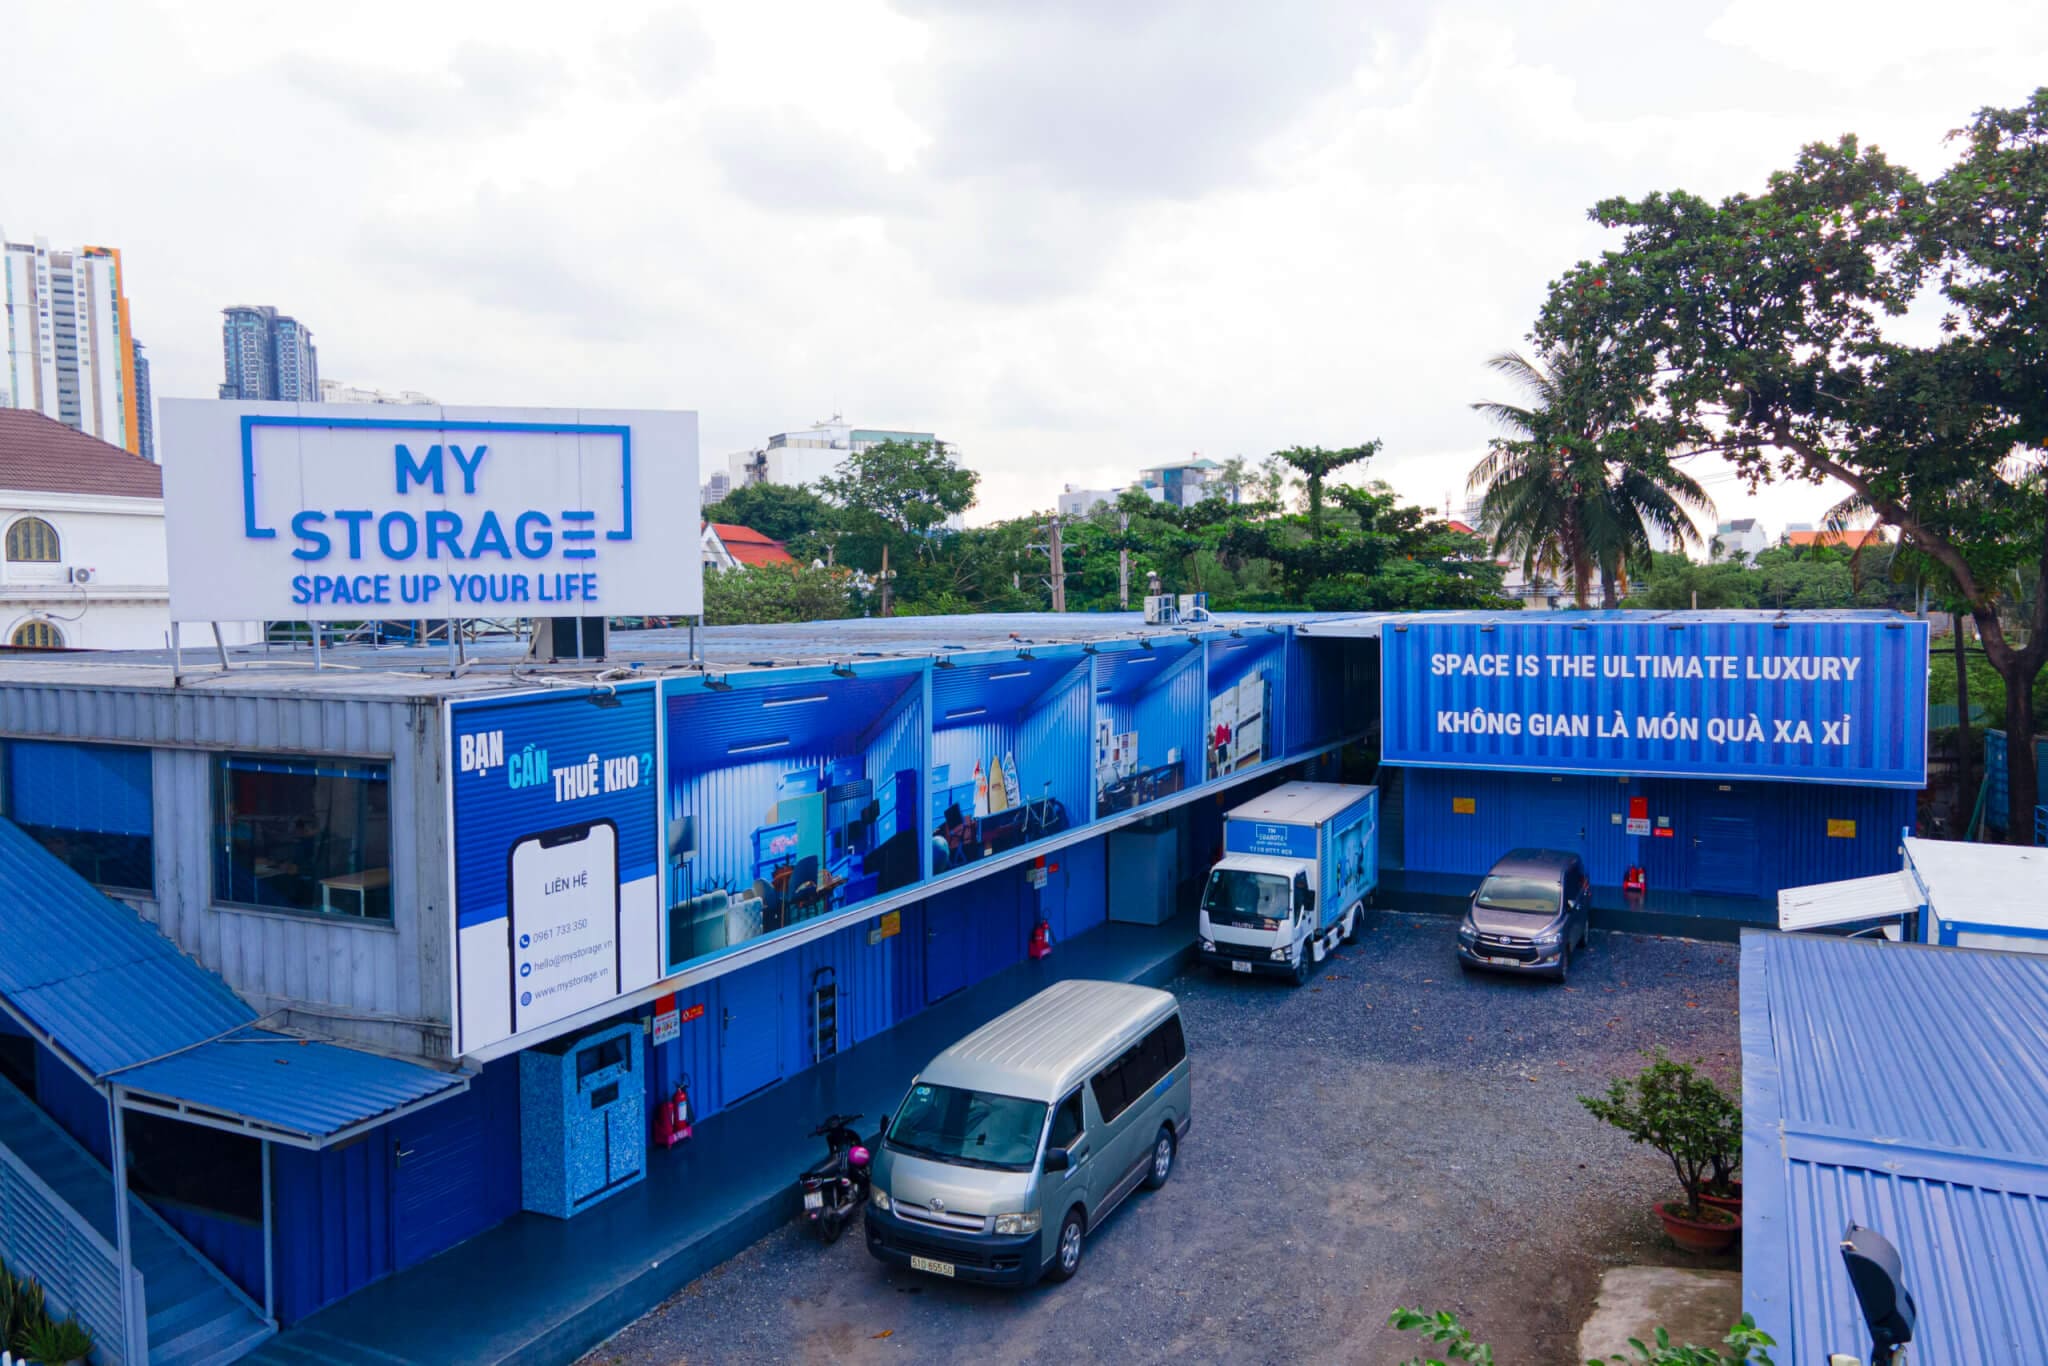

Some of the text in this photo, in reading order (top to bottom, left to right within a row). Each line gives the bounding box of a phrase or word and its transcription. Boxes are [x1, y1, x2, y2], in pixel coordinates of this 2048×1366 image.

[394, 444, 488, 494] MY
[291, 510, 597, 561] STORAGE
[292, 572, 598, 604] SPACE UP YOUR LIFE
[1431, 653, 1861, 681] SPACE IS THE ULTIMATE LUXURY
[1437, 706, 1852, 745] KHÔNG GIAN LÀ MÓN QUÀ XA XỈ
[460, 730, 504, 777] BẠN
[508, 743, 549, 790] CẦN
[552, 753, 600, 803] THUÊ
[544, 870, 588, 896] LIÊN HỆ
[533, 929, 553, 944] 0961
[556, 923, 572, 937] 733
